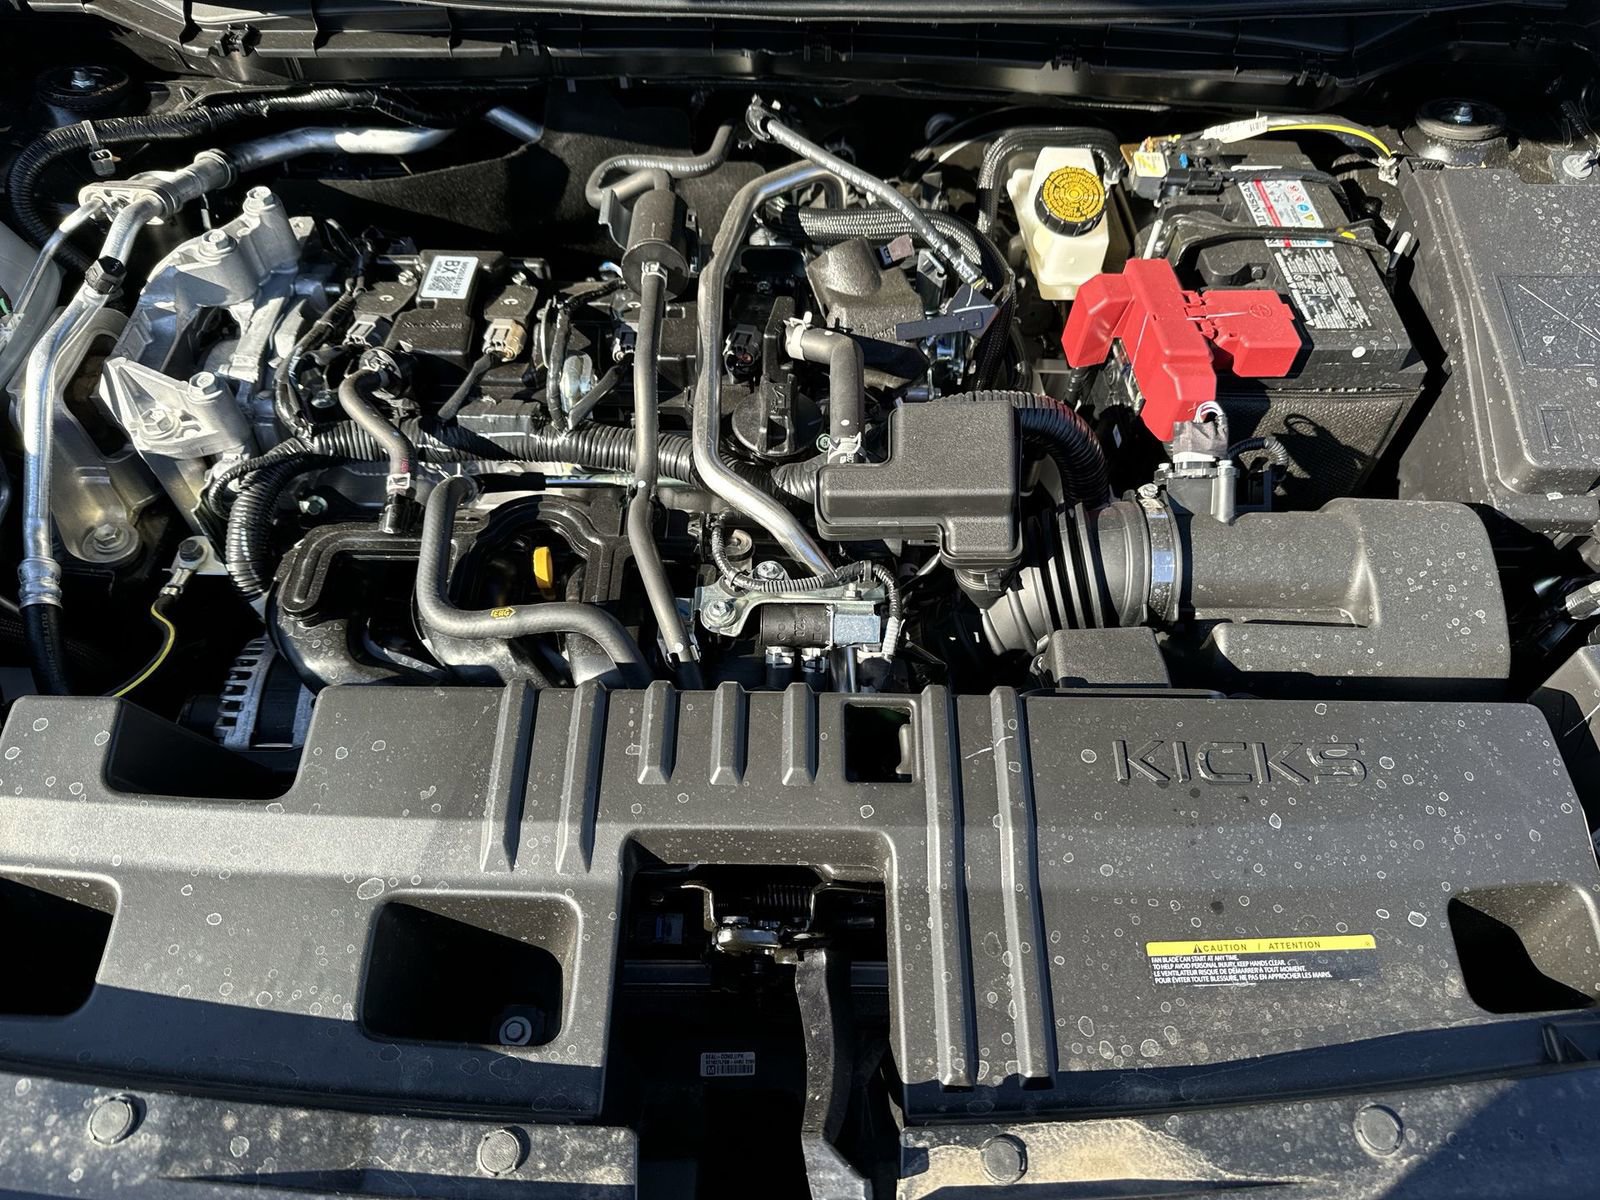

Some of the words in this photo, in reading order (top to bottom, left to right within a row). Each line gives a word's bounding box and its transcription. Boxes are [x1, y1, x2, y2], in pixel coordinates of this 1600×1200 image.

[1240, 182, 1262, 214] NISSAN
[441, 259, 460, 274] BX
[1112, 740, 1367, 786] KICKS
[1203, 943, 1247, 953] CAUTION
[1268, 941, 1321, 951] ATTENTION
[1172, 975, 1191, 983] ÉVITER
[1268, 972, 1302, 980] APPROCHER
[1198, 968, 1219, 976] RISQUE
[1229, 966, 1259, 974] DÉMARRER
